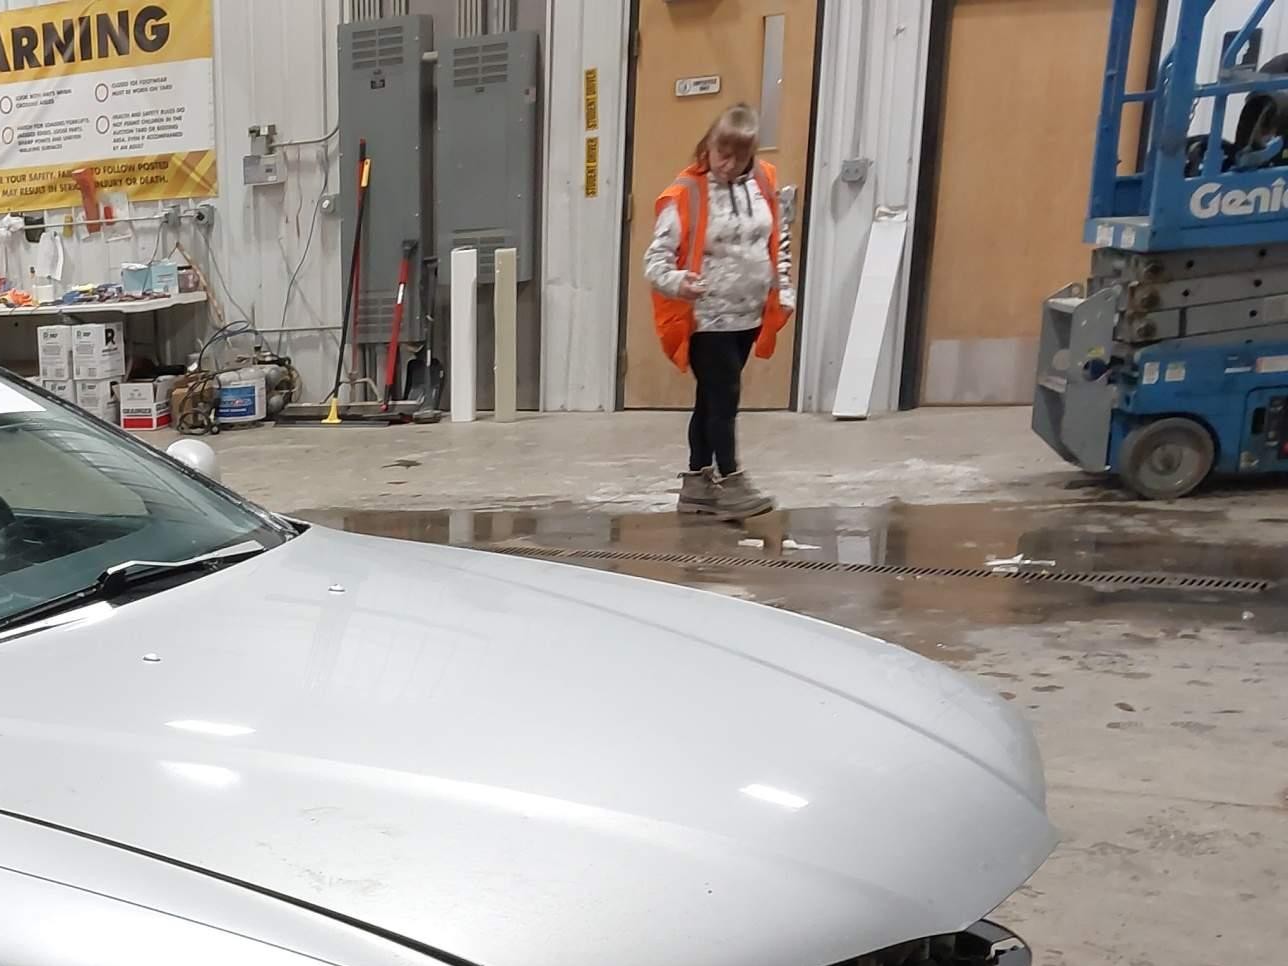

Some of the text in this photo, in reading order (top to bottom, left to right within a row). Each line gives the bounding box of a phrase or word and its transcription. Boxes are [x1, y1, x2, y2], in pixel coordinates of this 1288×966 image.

[6, 174, 27, 184] YOUR
[103, 163, 136, 175] FOLLOW
[137, 161, 169, 172] POSTED
[2, 187, 17, 198] MAY
[20, 185, 46, 196] RESULT
[48, 184, 57, 193] IN
[125, 176, 137, 186] OR
[1190, 178, 1288, 219] Geni
